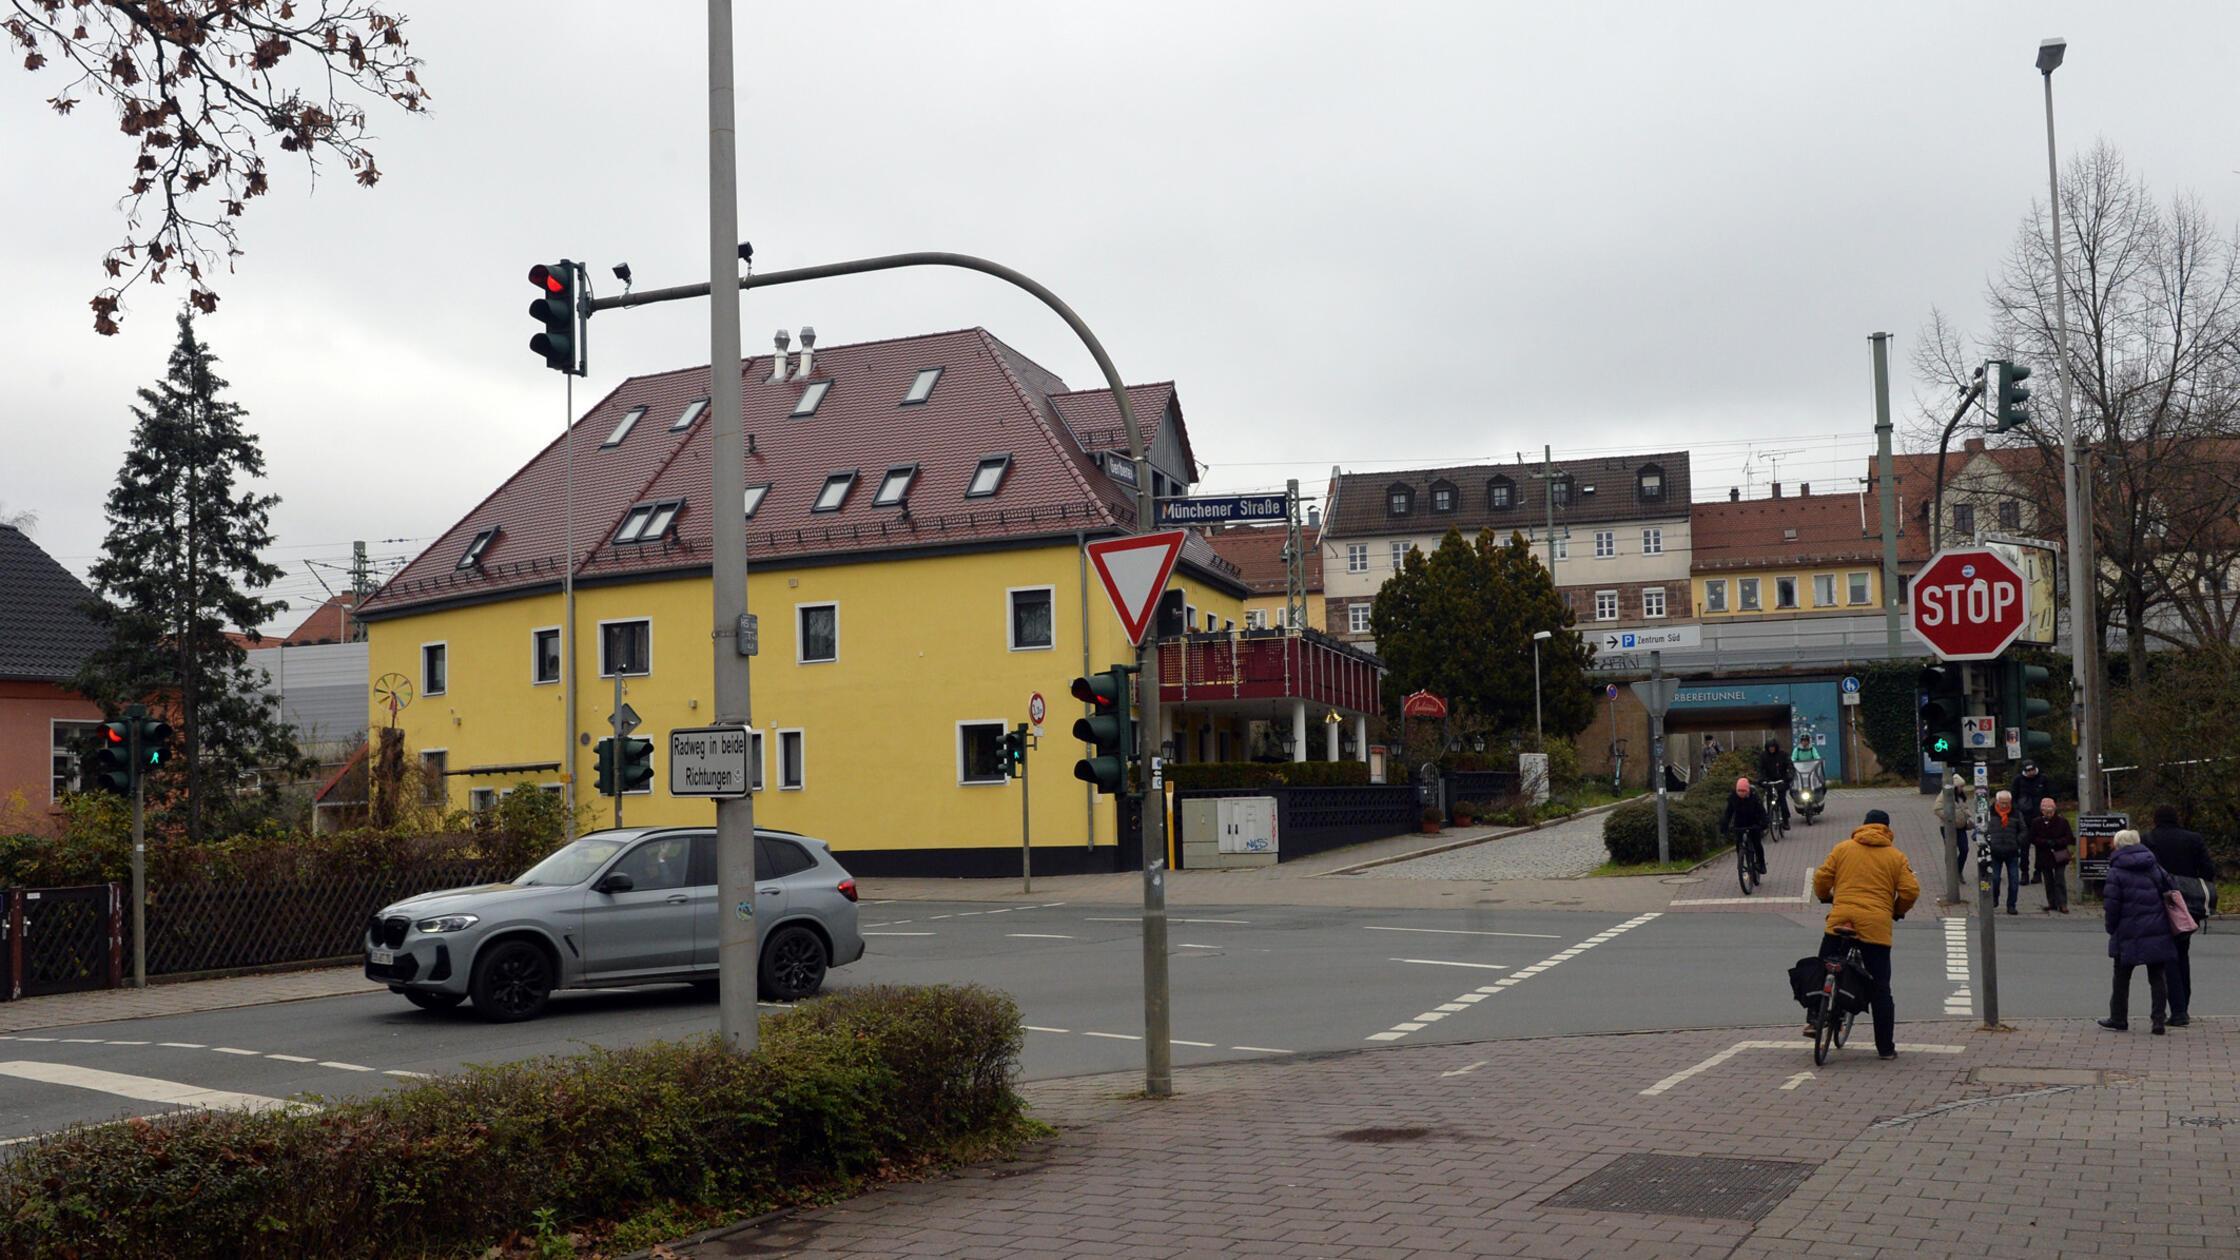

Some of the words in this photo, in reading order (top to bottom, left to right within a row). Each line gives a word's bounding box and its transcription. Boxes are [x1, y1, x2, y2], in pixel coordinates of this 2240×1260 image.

[1162, 502, 1233, 519] Münchener
[1240, 499, 1280, 516] Straße
[1922, 581, 2015, 627] STOP
[1624, 636, 1633, 646] P
[1637, 635, 1665, 645] Zentrum
[1668, 632, 1681, 643] Süd
[1673, 691, 1746, 703] RBEREITUNNEL
[674, 736, 705, 760] Radweg
[709, 735, 718, 755] in
[721, 734, 744, 754] beide
[685, 767, 732, 791] Richtungen
